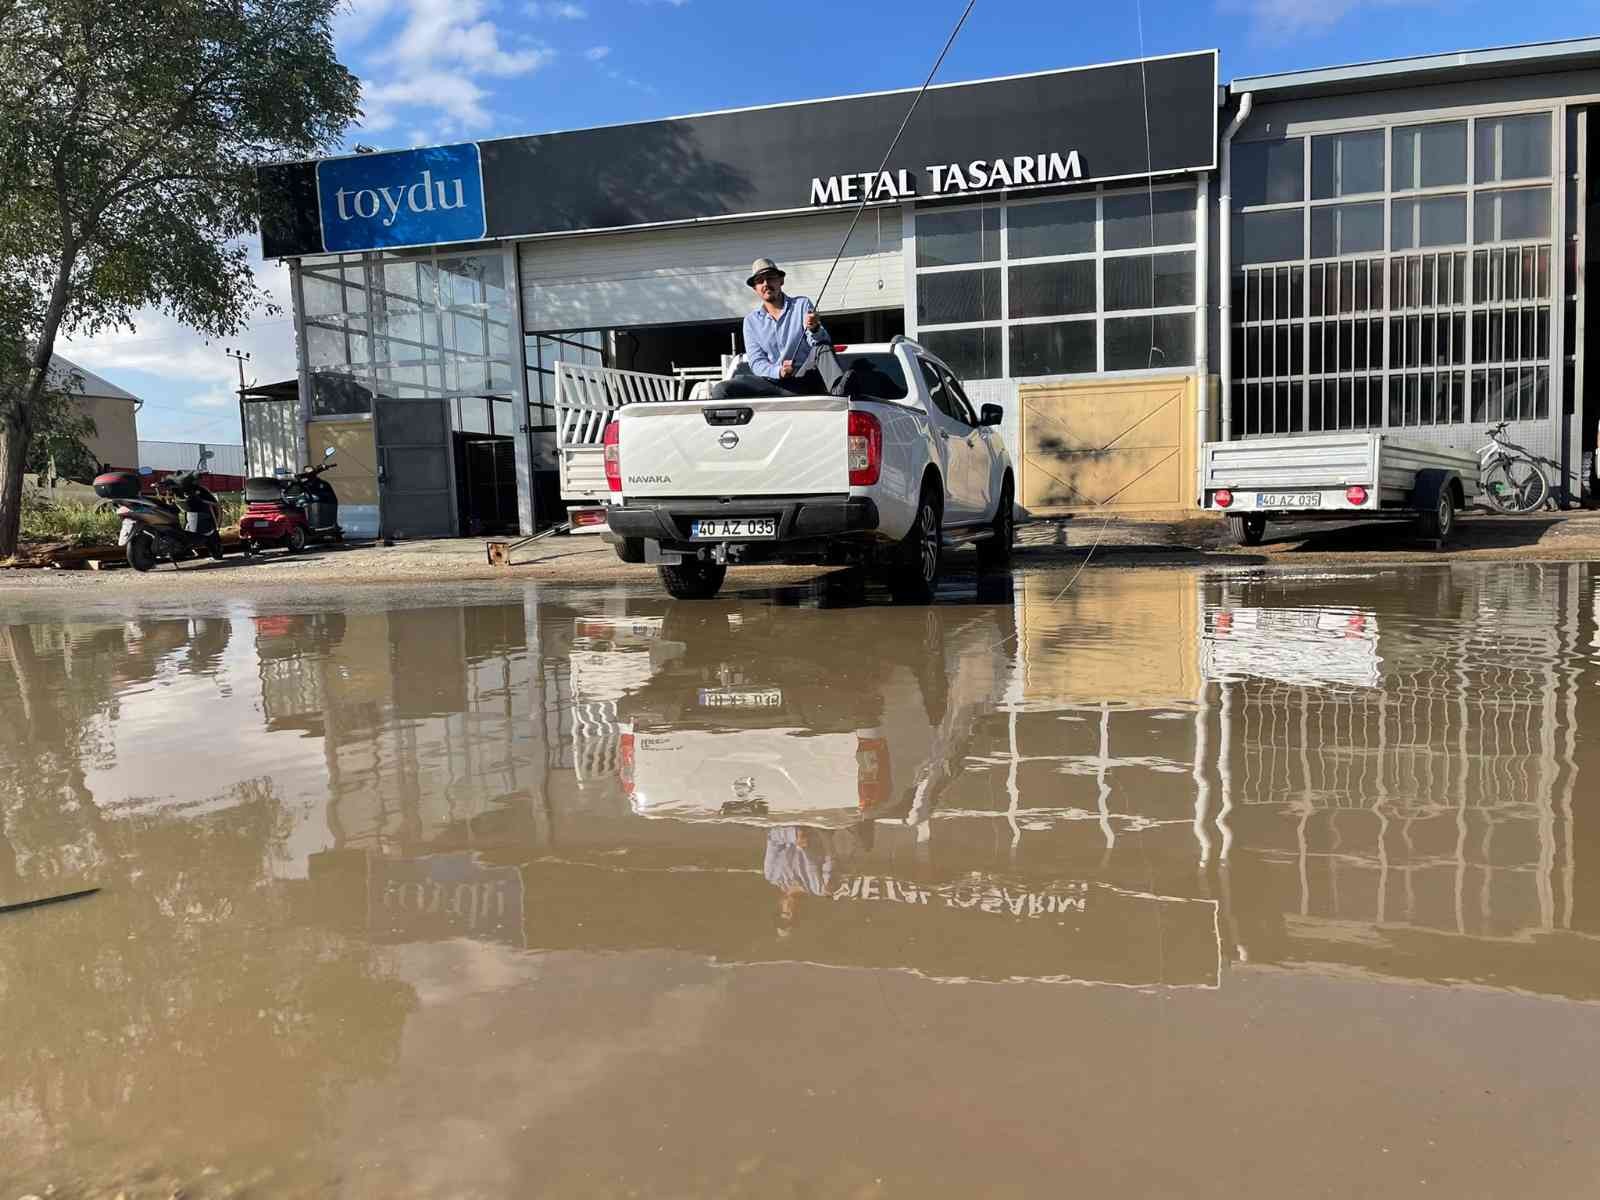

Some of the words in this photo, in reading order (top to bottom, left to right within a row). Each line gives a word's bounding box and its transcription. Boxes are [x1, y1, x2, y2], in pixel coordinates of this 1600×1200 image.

[810, 169, 915, 204] METAL
[926, 150, 1083, 193] TASARIM
[335, 170, 467, 226] toydu
[1263, 495, 1276, 506] 40
[1280, 495, 1296, 506] AZ
[1299, 495, 1319, 506] 035
[699, 520, 716, 536] 40
[722, 520, 741, 536] AZ
[748, 519, 774, 535] 035
